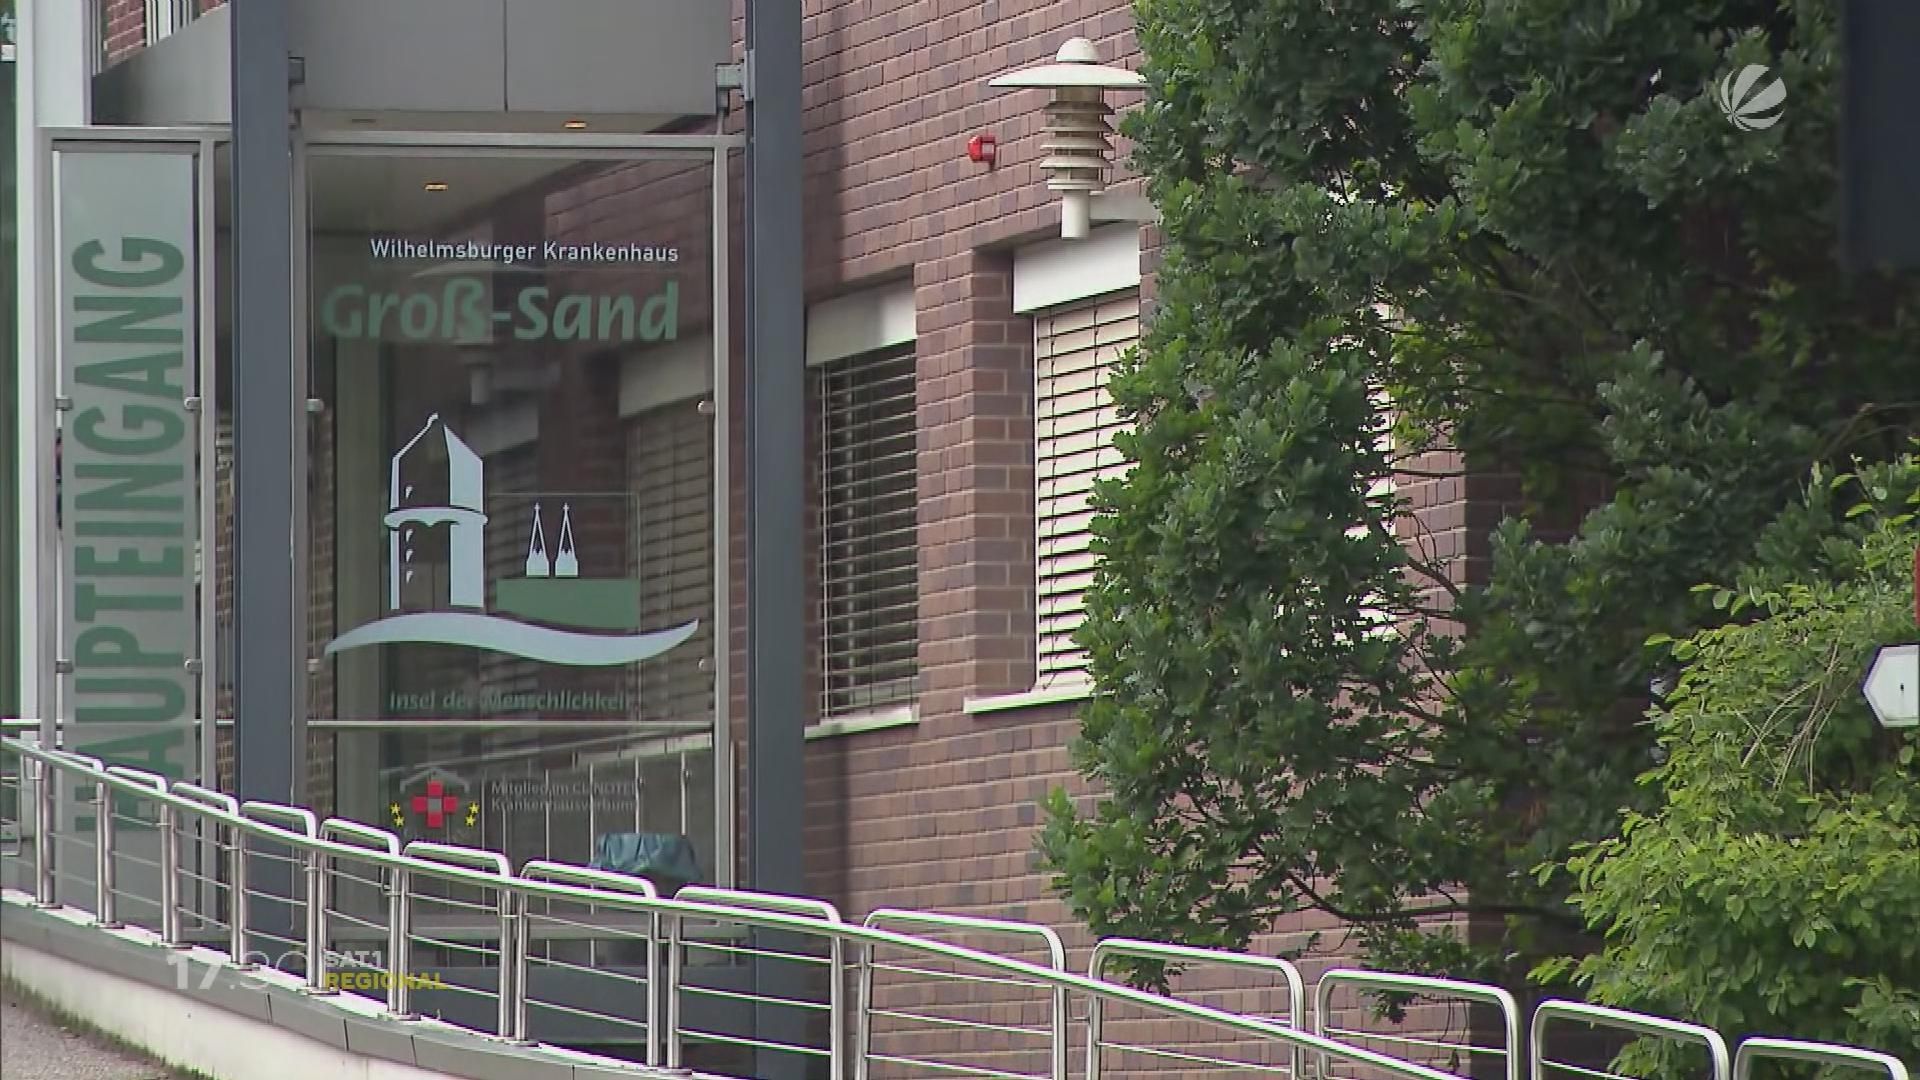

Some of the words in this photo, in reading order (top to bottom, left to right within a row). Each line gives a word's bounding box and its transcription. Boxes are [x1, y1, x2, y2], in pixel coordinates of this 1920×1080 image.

[371, 239, 536, 263] Wilhelmsburger
[543, 241, 679, 262] Krankenhaus
[322, 278, 680, 342] Groß-Sand
[390, 690, 435, 710] Insel
